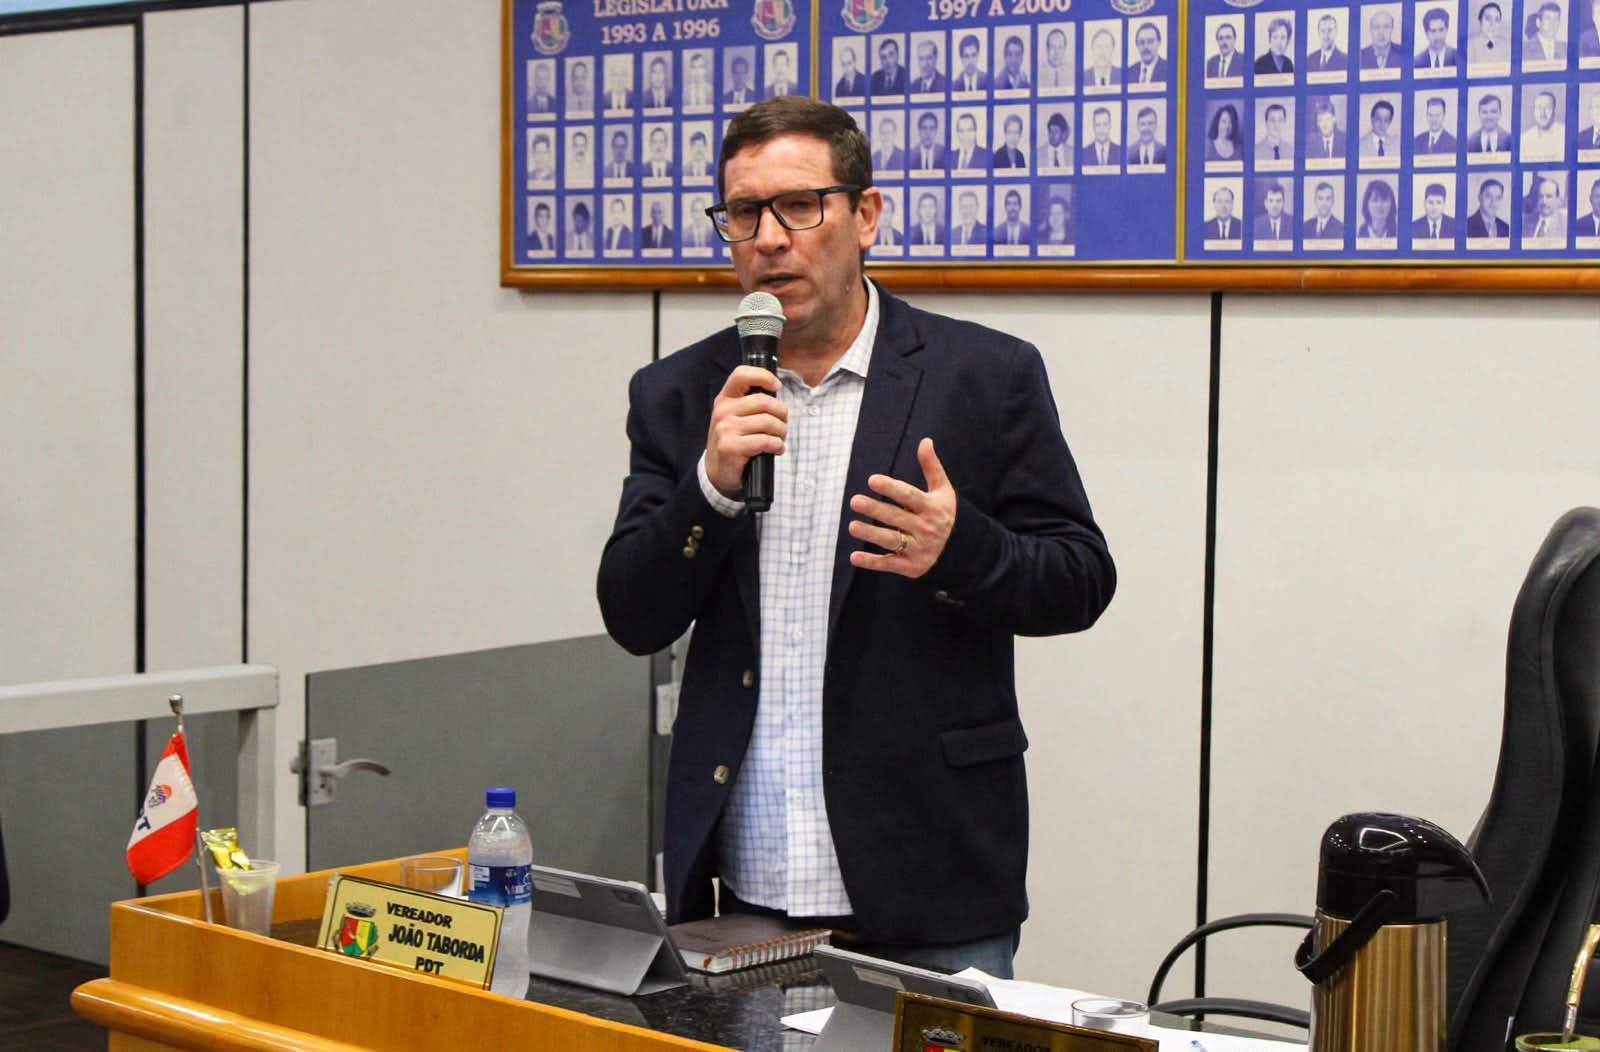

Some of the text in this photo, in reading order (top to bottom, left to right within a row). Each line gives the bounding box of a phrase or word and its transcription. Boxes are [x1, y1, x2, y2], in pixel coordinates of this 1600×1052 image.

[928, 0, 1071, 20] 1997 A 2000
[601, 18, 720, 44] 1993 A 1996
[387, 902, 452, 928] VEREADOR
[388, 923, 485, 963] JOÃO TABORDA
[415, 956, 444, 975] PDT
